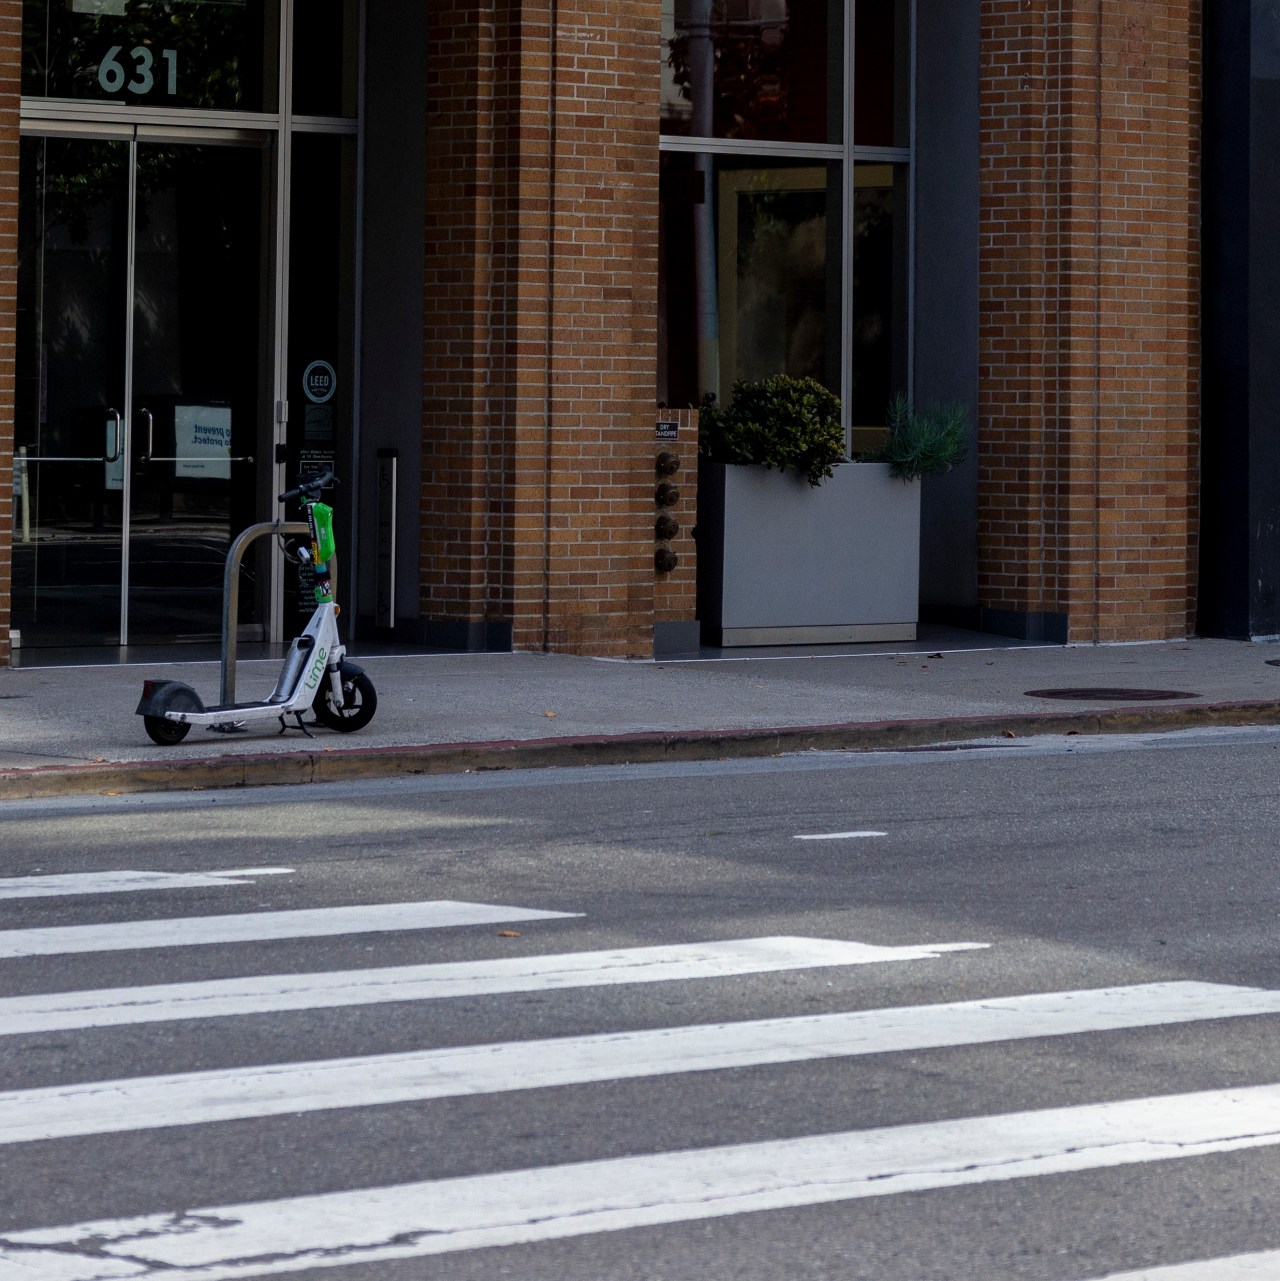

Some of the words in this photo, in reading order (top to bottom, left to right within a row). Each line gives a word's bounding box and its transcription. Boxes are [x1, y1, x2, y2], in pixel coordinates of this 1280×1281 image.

[98, 46, 177, 94] 631
[310, 376, 329, 386] LEED
[305, 647, 327, 689] Lime
